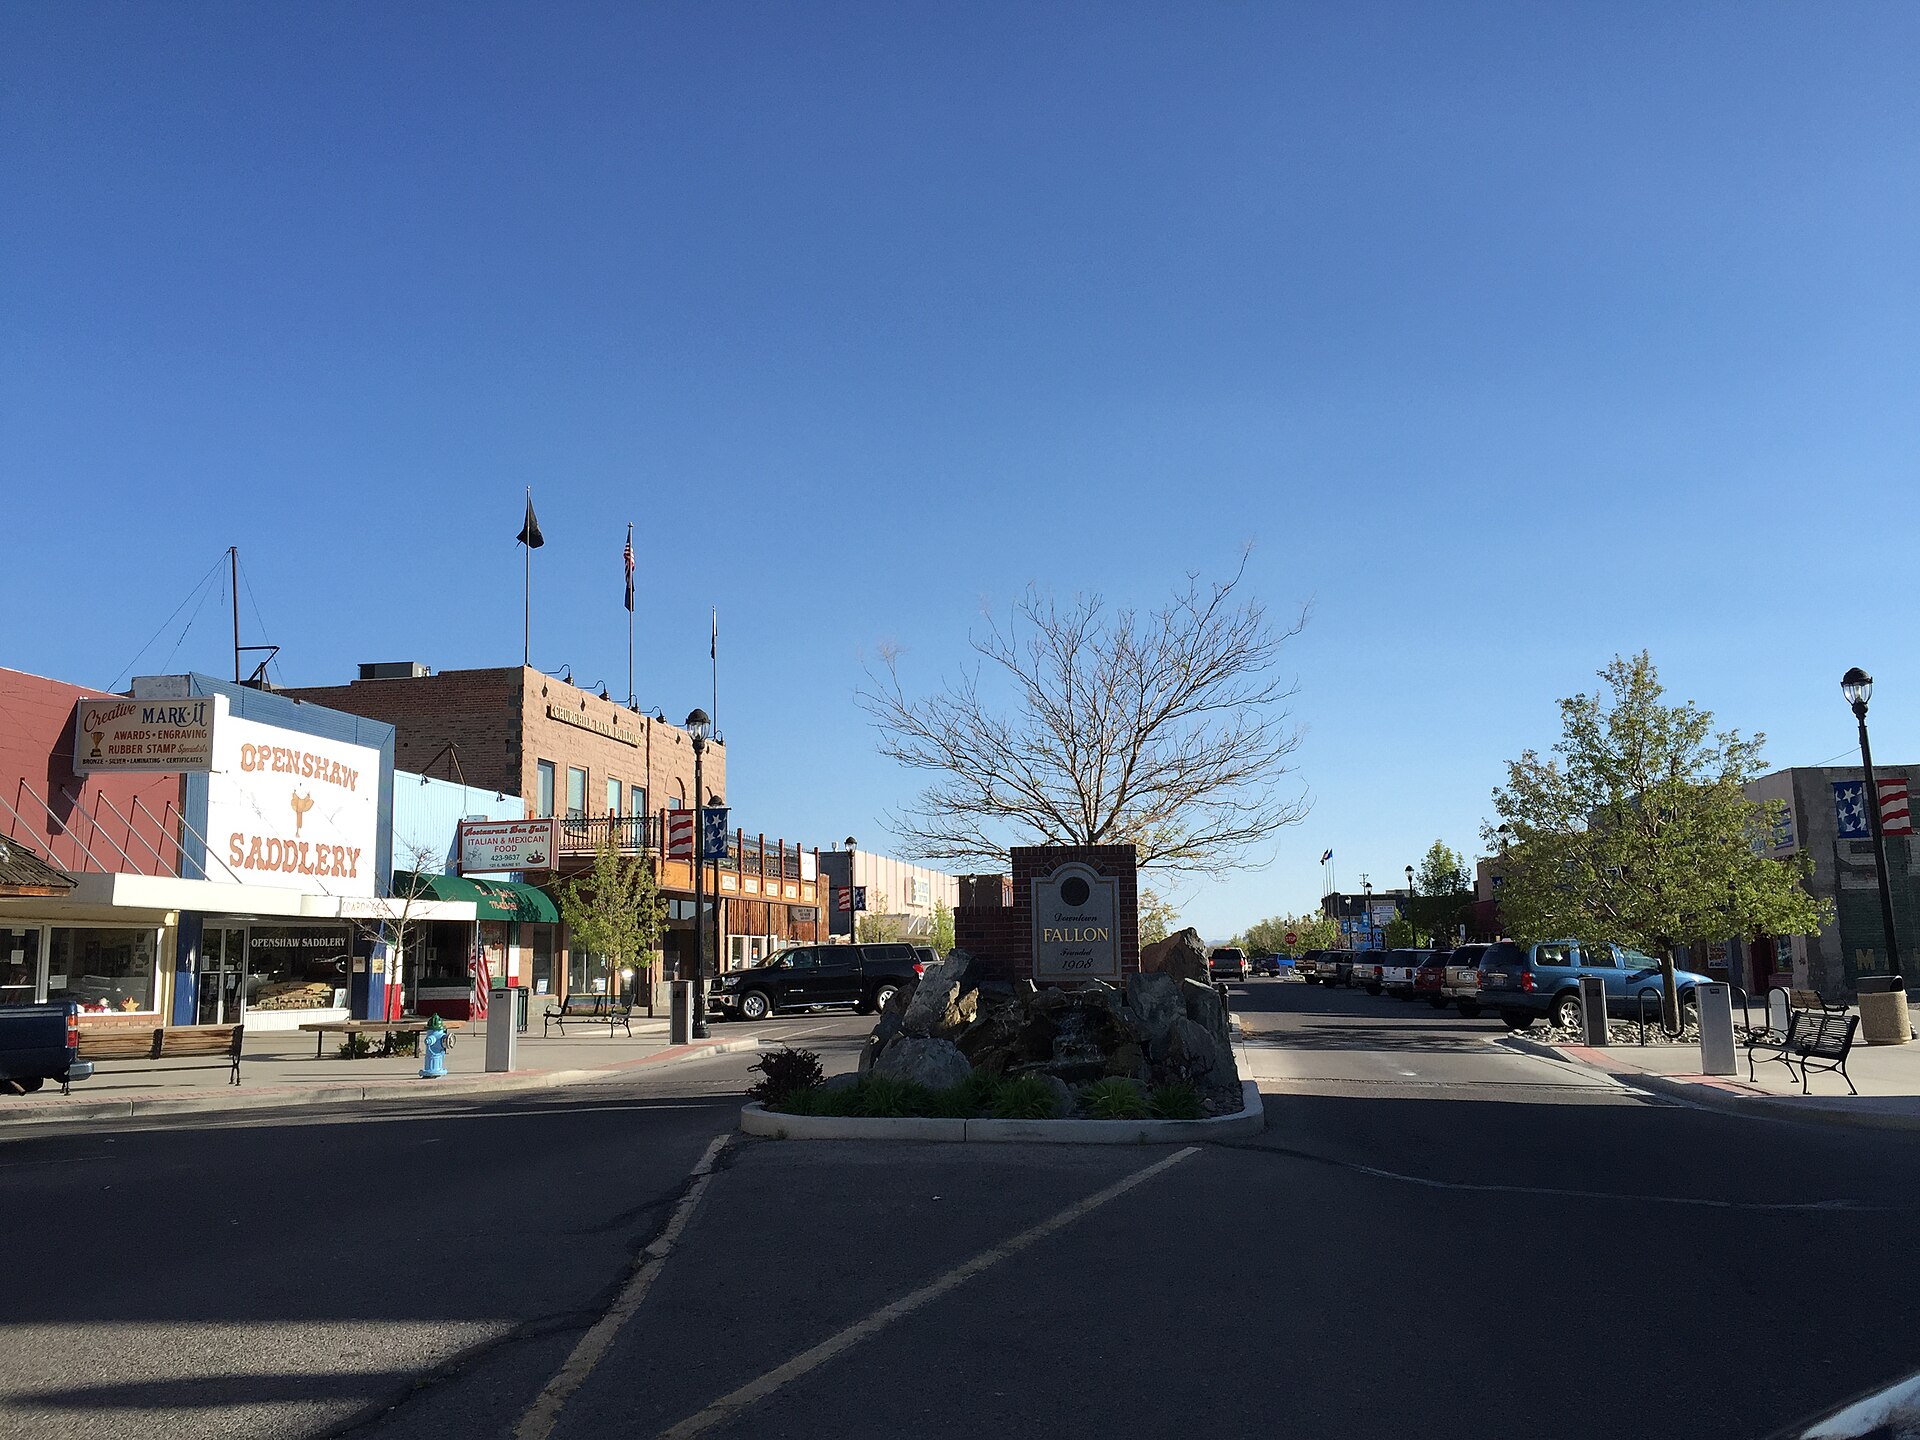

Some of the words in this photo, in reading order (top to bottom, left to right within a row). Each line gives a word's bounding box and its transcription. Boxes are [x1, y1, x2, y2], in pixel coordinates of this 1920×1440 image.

[83, 703, 137, 733] Creative
[554, 705, 592, 730] CHURCHILL
[593, 720, 613, 737] BANK
[613, 726, 642, 746] BUILDING
[113, 730, 151, 741] AWARDS
[157, 729, 207, 740] ENGRAVING
[108, 744, 143, 755] RUBBER
[146, 743, 177, 755] STAMP
[240, 742, 359, 792] OPENSHAW
[463, 826, 508, 837] Restaurant
[467, 837, 498, 846] ITALIAN
[500, 837, 506, 845] &
[508, 835, 545, 844] MEXICAN
[494, 845, 518, 853] FOOD
[229, 832, 361, 879] SADDLERY
[1053, 912, 1098, 922] Downtown
[1043, 927, 1109, 942] FALLON
[251, 938, 300, 948] OPENSHAW
[301, 937, 347, 948] SADDLERY
[1059, 948, 1093, 956] Founded
[1061, 957, 1094, 971] 1908
